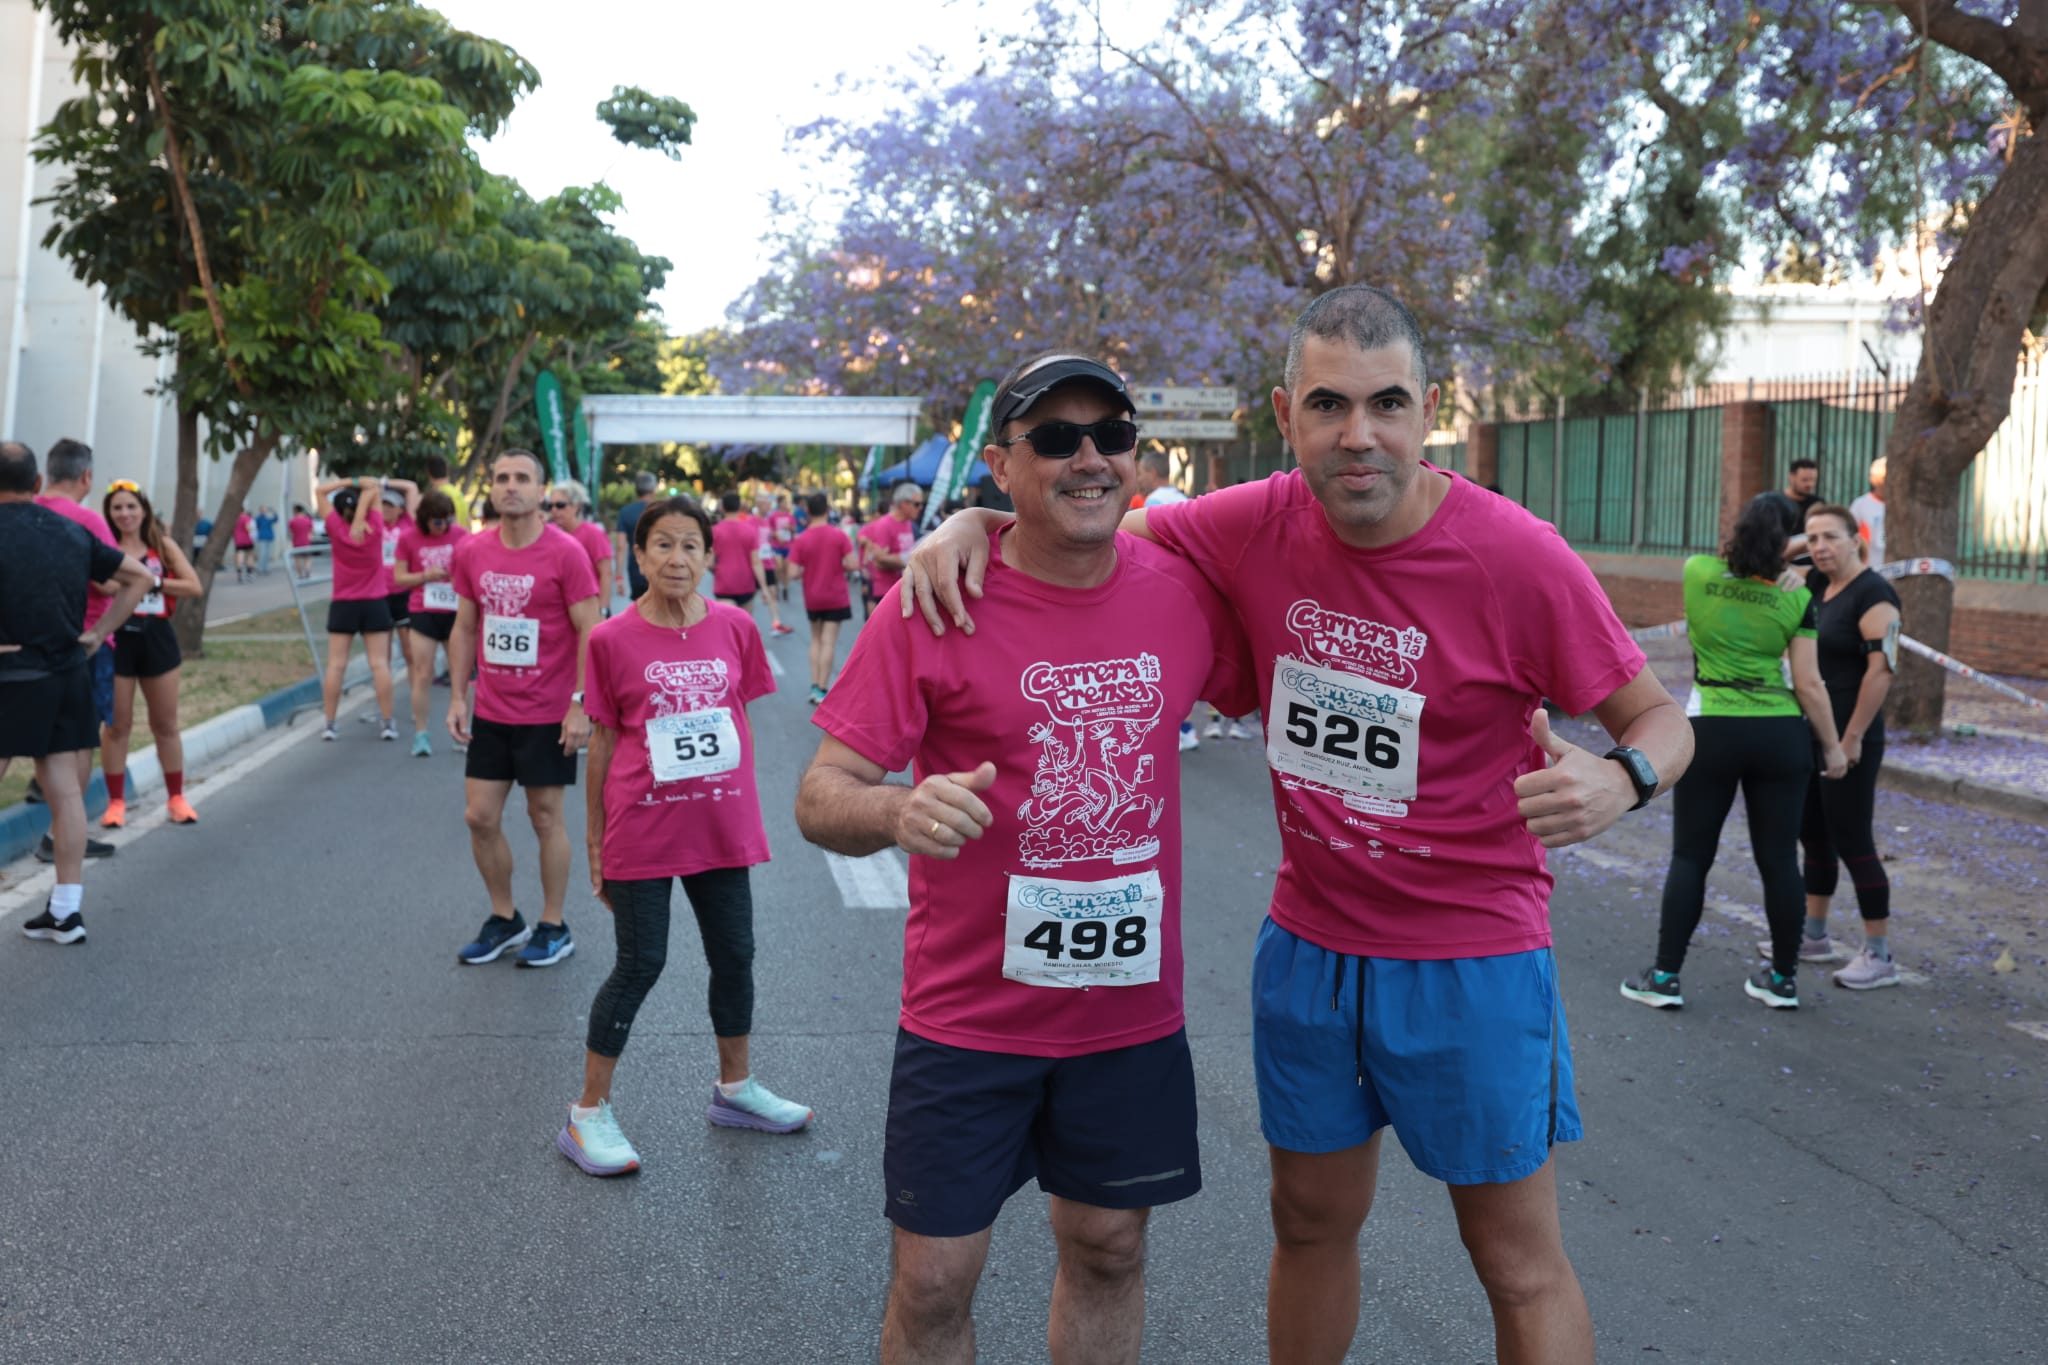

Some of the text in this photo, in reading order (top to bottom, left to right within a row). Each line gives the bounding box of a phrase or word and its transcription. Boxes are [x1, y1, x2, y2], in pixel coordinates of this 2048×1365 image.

[1706, 582, 1780, 610] SLOWGIRL
[1294, 605, 1399, 649] Carrera
[1402, 631, 1423, 644] de
[487, 633, 530, 653] 436
[1309, 630, 1402, 672] Prensa
[1030, 660, 1140, 690] Carrera
[1140, 656, 1156, 668] de
[1054, 679, 1150, 711] Prensa
[1299, 674, 1378, 708] Carrera
[1313, 694, 1383, 722] Prensa
[674, 733, 720, 761] 53
[1286, 701, 1401, 770] 526
[1041, 889, 1126, 908] Carrera
[1057, 903, 1131, 918] Prensa
[1024, 916, 1147, 960] 498
